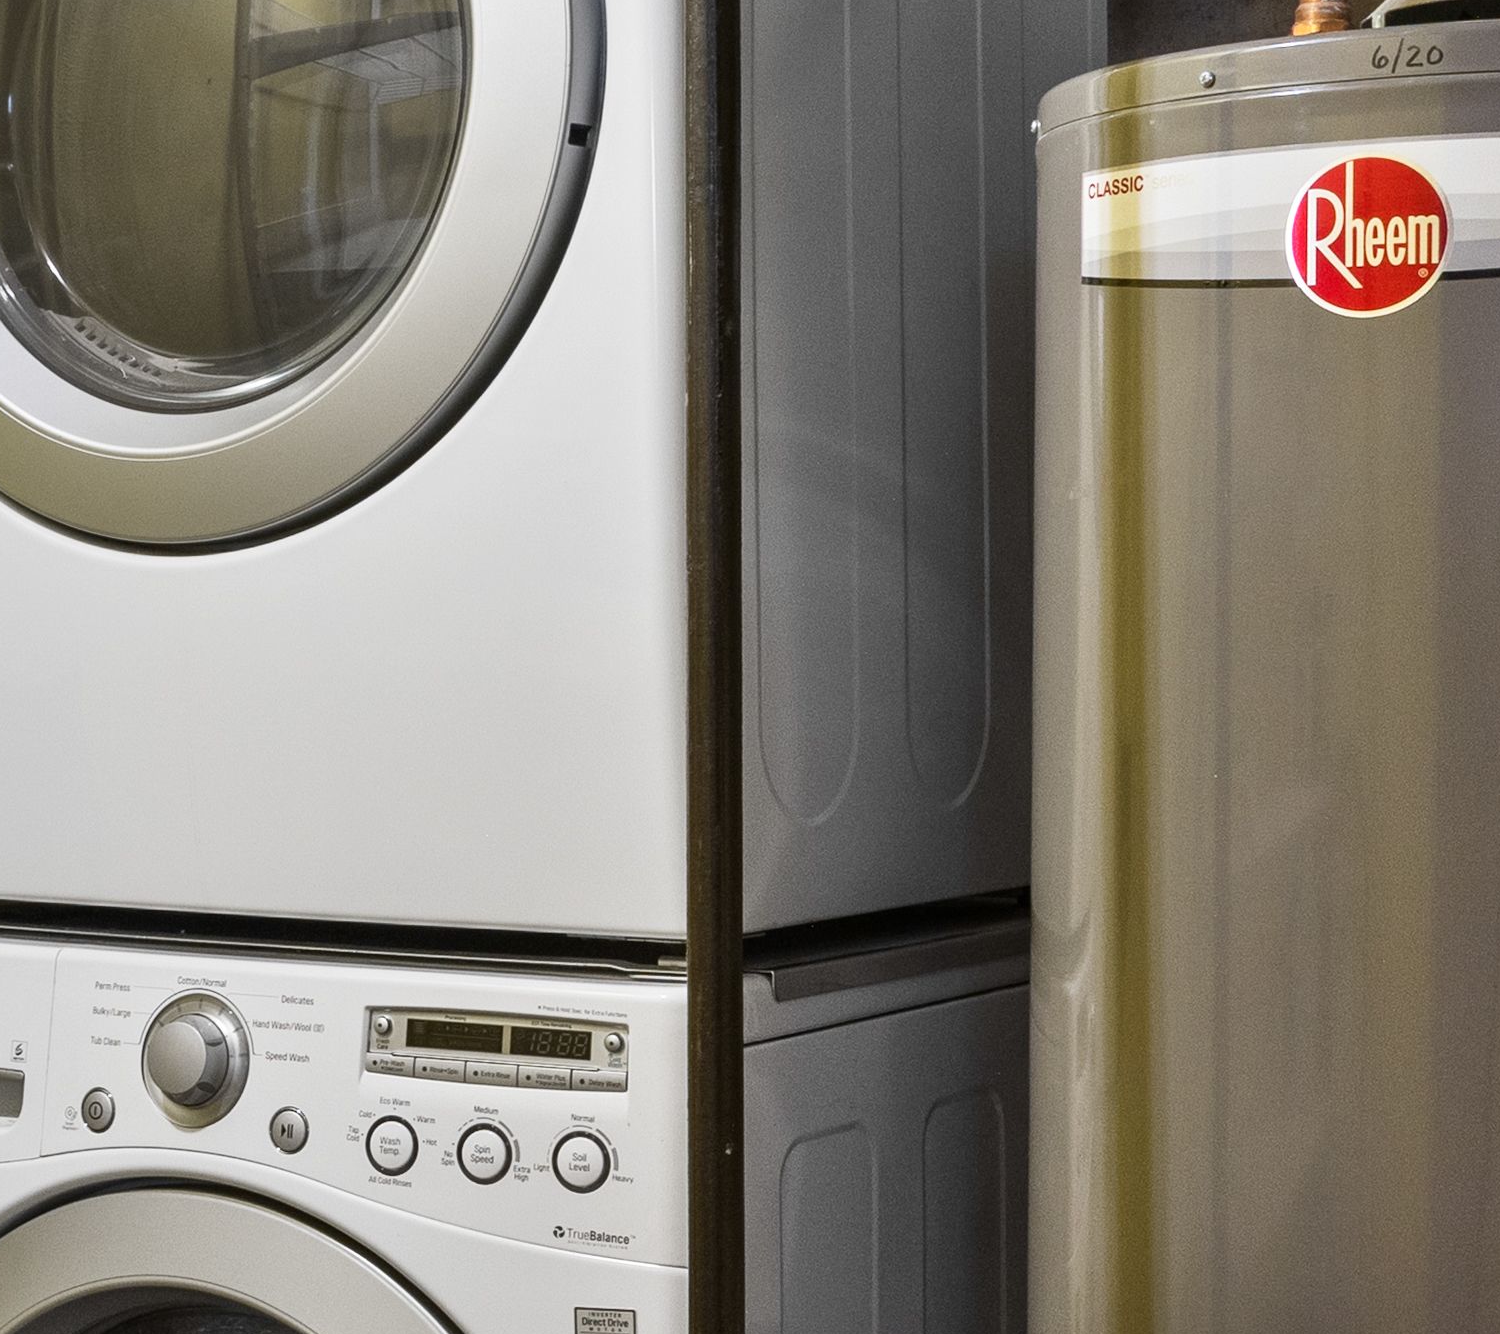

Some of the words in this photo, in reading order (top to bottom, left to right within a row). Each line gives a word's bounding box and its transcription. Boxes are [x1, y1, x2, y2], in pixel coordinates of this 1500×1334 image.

[1371, 39, 1444, 74] 6/20
[1088, 175, 1144, 200] CLASSIC
[1307, 162, 1440, 289] Rheem
[95, 981, 111, 992] Perm
[112, 983, 131, 993] Press
[177, 976, 227, 988] Cotton/Normal
[281, 995, 314, 1006] Delicates
[92, 1006, 132, 1019] Bulky/Large
[252, 1019, 269, 1030] Hand
[270, 1021, 312, 1032] Wash/Wool
[104, 1037, 121, 1047] Clean
[265, 1051, 285, 1063] Speed
[287, 1053, 310, 1063] Wash
[474, 1105, 499, 1115] Medium
[571, 1114, 595, 1123] Normal
[380, 1136, 401, 1145] Wash
[474, 1145, 491, 1155] Spin
[441, 1157, 455, 1166] Spin
[470, 1154, 494, 1165] Speed
[572, 1152, 587, 1162] Soil
[513, 1165, 531, 1174] Extra
[533, 1163, 550, 1173] Light
[568, 1162, 590, 1172] Level
[514, 1173, 529, 1182] High
[612, 1174, 634, 1184] Heavy
[392, 1179, 412, 1188] Rinses
[567, 1228, 630, 1245] TrueBalance
[582, 1317, 606, 1326] Direct
[608, 1318, 629, 1327] Drive
